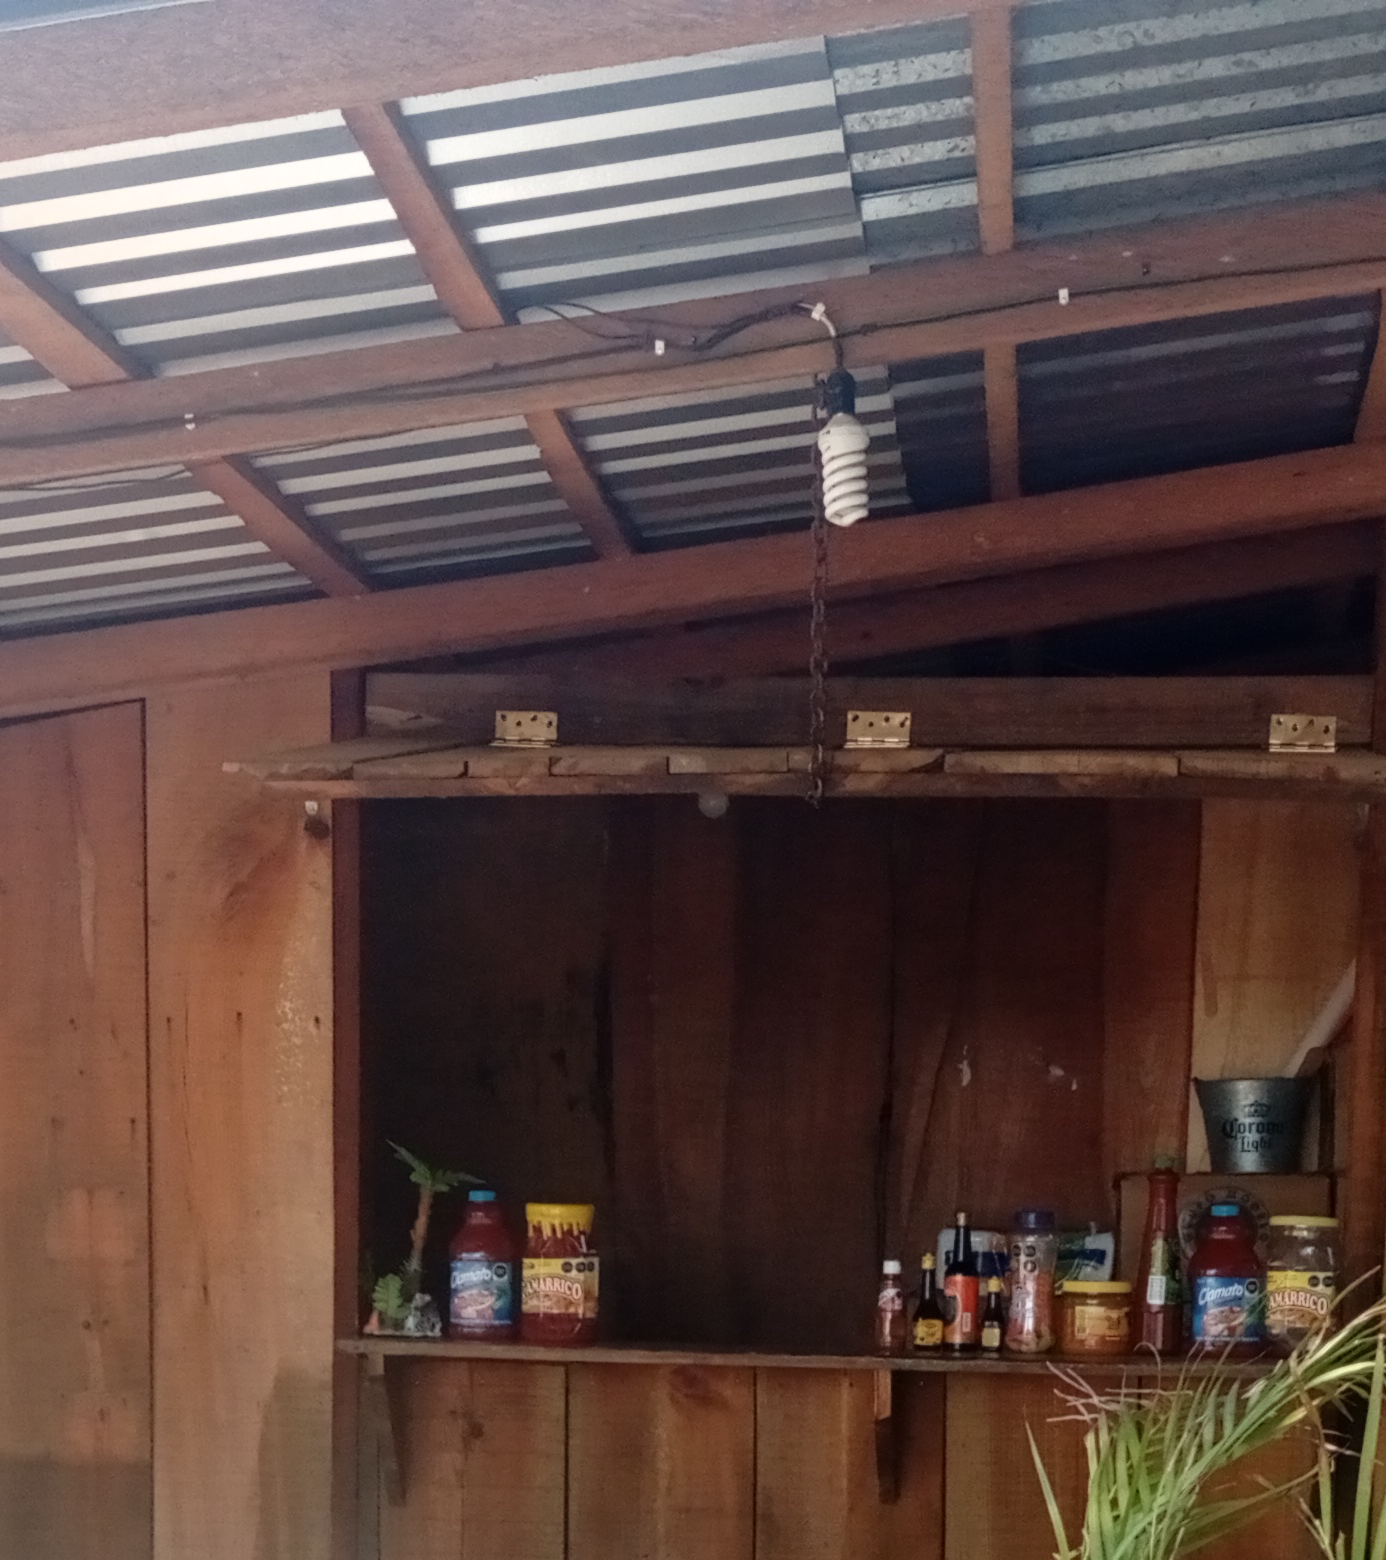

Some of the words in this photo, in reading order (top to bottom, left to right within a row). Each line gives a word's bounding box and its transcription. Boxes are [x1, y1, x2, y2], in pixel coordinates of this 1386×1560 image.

[1221, 1117, 1284, 1140] Corona
[450, 1267, 492, 1289] Clamato
[1198, 1282, 1244, 1306] Clamato
[1268, 1290, 1328, 1315] AMARRICO
